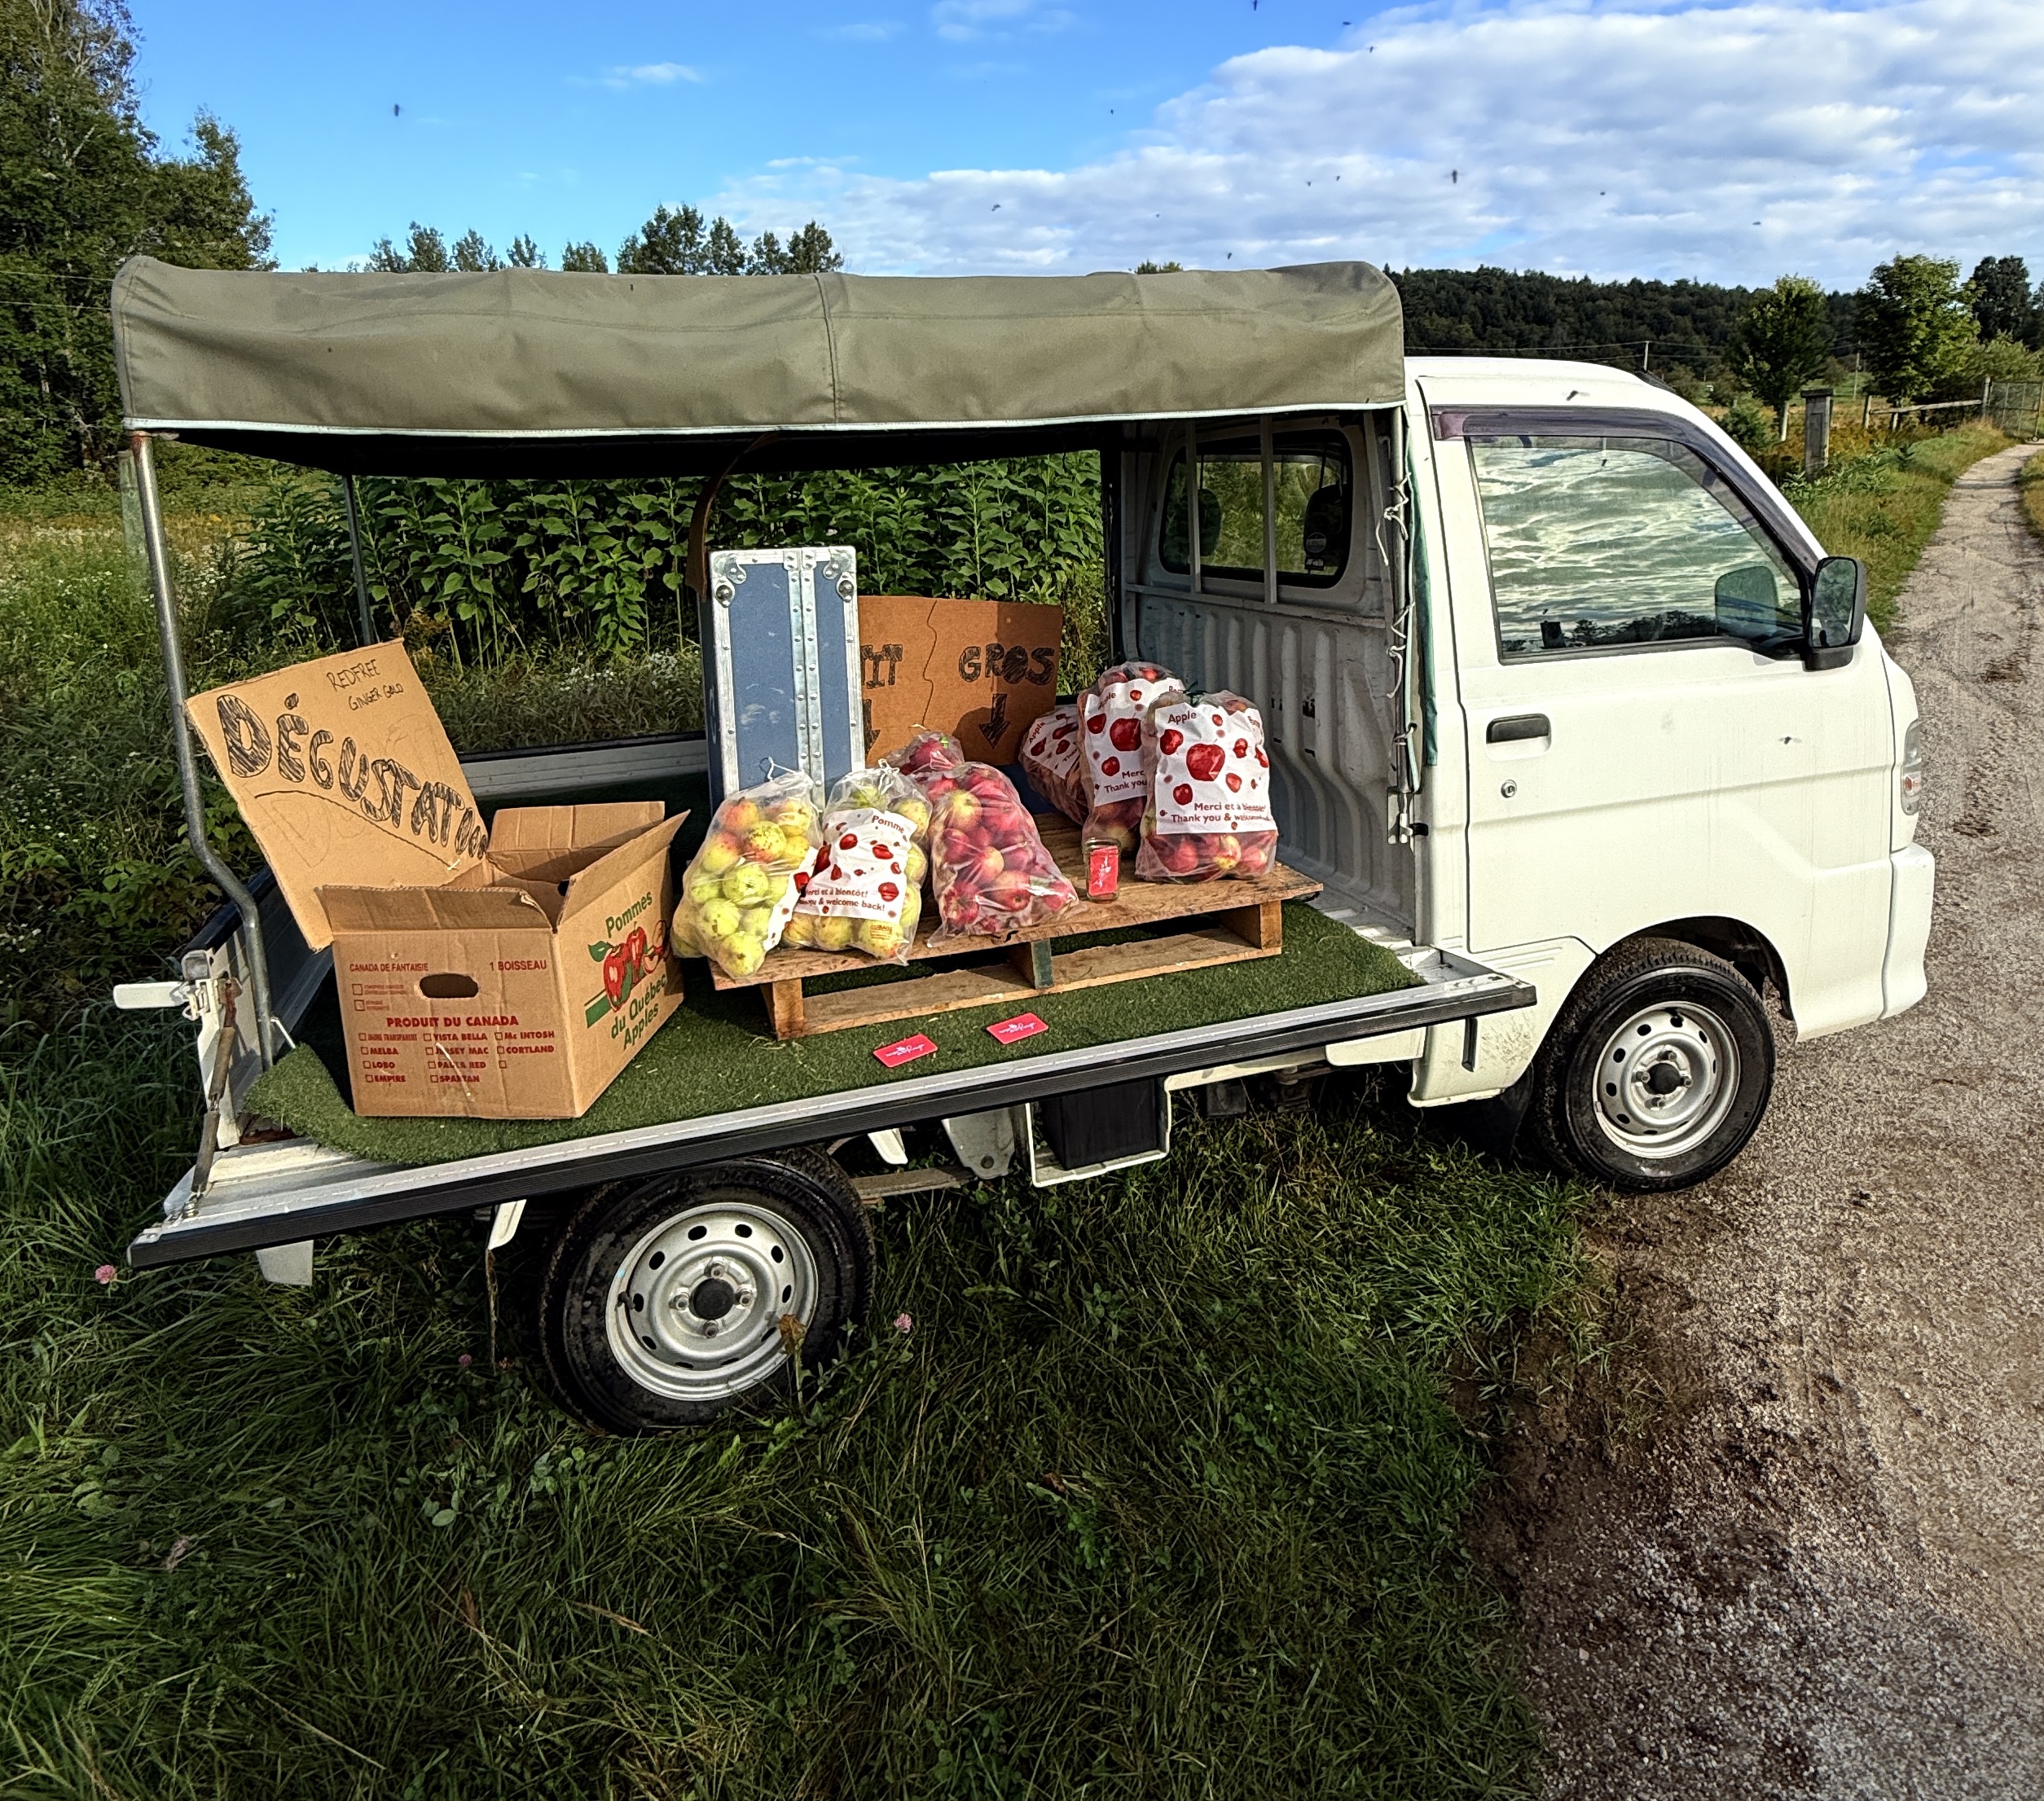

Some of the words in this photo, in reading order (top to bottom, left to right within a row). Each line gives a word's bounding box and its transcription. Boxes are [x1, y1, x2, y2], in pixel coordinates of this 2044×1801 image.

[958, 643, 1056, 686] GROS
[326, 658, 381, 692] REDFREE
[348, 687, 383, 711] GINGER
[1167, 709, 1198, 726] Apple
[1029, 722, 1046, 744] Apple
[1122, 770, 1145, 779] Merc
[1104, 781, 1129, 793] Thank
[1130, 780, 1147, 789] you
[1193, 802, 1222, 811] Merci
[871, 815, 905, 834] Pomme
[1171, 814, 1202, 823] Thank
[1202, 815, 1221, 824] you
[1224, 813, 1232, 822] &
[818, 898, 824, 906] &
[826, 898, 859, 907] welcome
[861, 900, 886, 911] back!
[605, 890, 653, 938] Pommes
[349, 963, 380, 973] CANADA
[380, 963, 391, 972] DE
[489, 961, 495, 971] 1
[498, 960, 547, 971] BOISSEAU
[611, 1015, 626, 1039] du
[629, 973, 667, 1021] Québec
[386, 1017, 439, 1028] PRODUIT
[443, 1017, 461, 1027] DU
[466, 1015, 519, 1026] CANADA
[623, 1003, 659, 1051] Apples
[433, 1033, 459, 1041] VISTA
[520, 1030, 555, 1039] INTOSH
[370, 1047, 398, 1055] MELBA
[468, 1047, 489, 1055] MAC
[506, 1045, 555, 1054] CORTLAND
